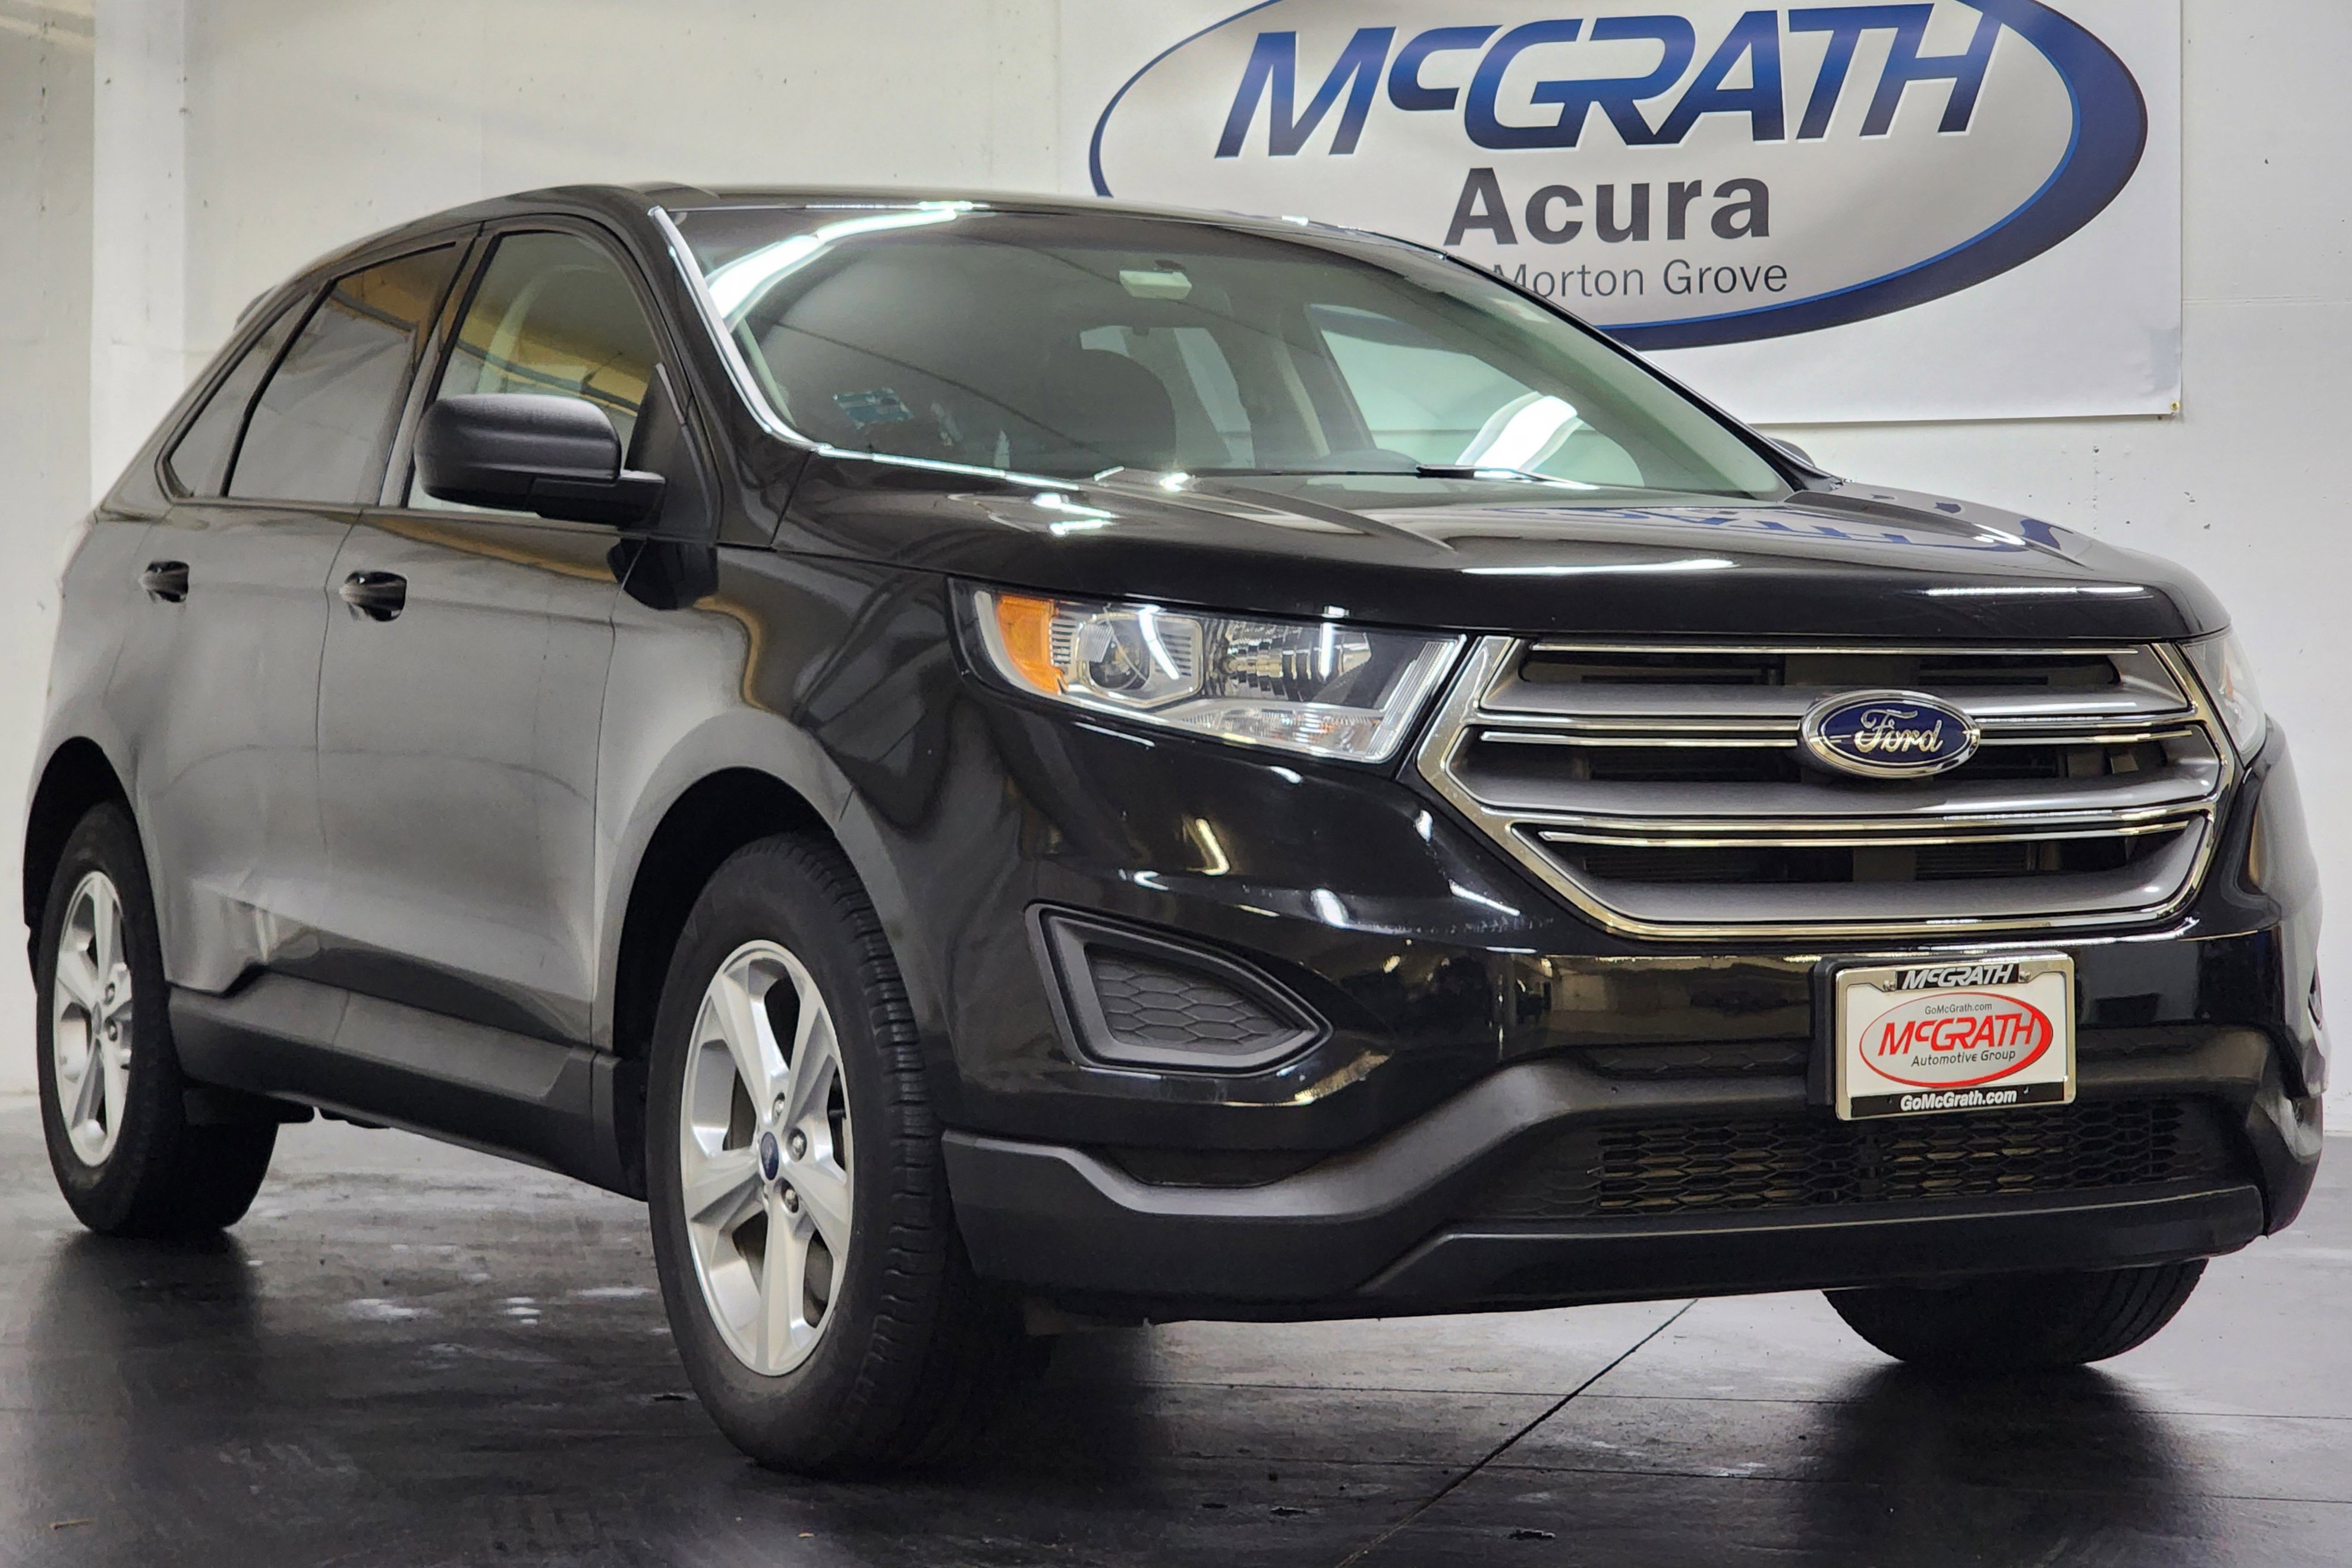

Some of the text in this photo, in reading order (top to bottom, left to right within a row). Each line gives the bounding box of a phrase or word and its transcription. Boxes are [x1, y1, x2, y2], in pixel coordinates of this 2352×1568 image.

[1443, 166, 1770, 246] Acura
[1664, 259, 1788, 295] Grove
[1853, 709, 1944, 754] Ford
[1924, 1002, 1992, 1015] GoMcGrath.com
[1910, 1049, 2016, 1068] Automotive Group
[1900, 1088, 2017, 1112] GoMcGrath.com
